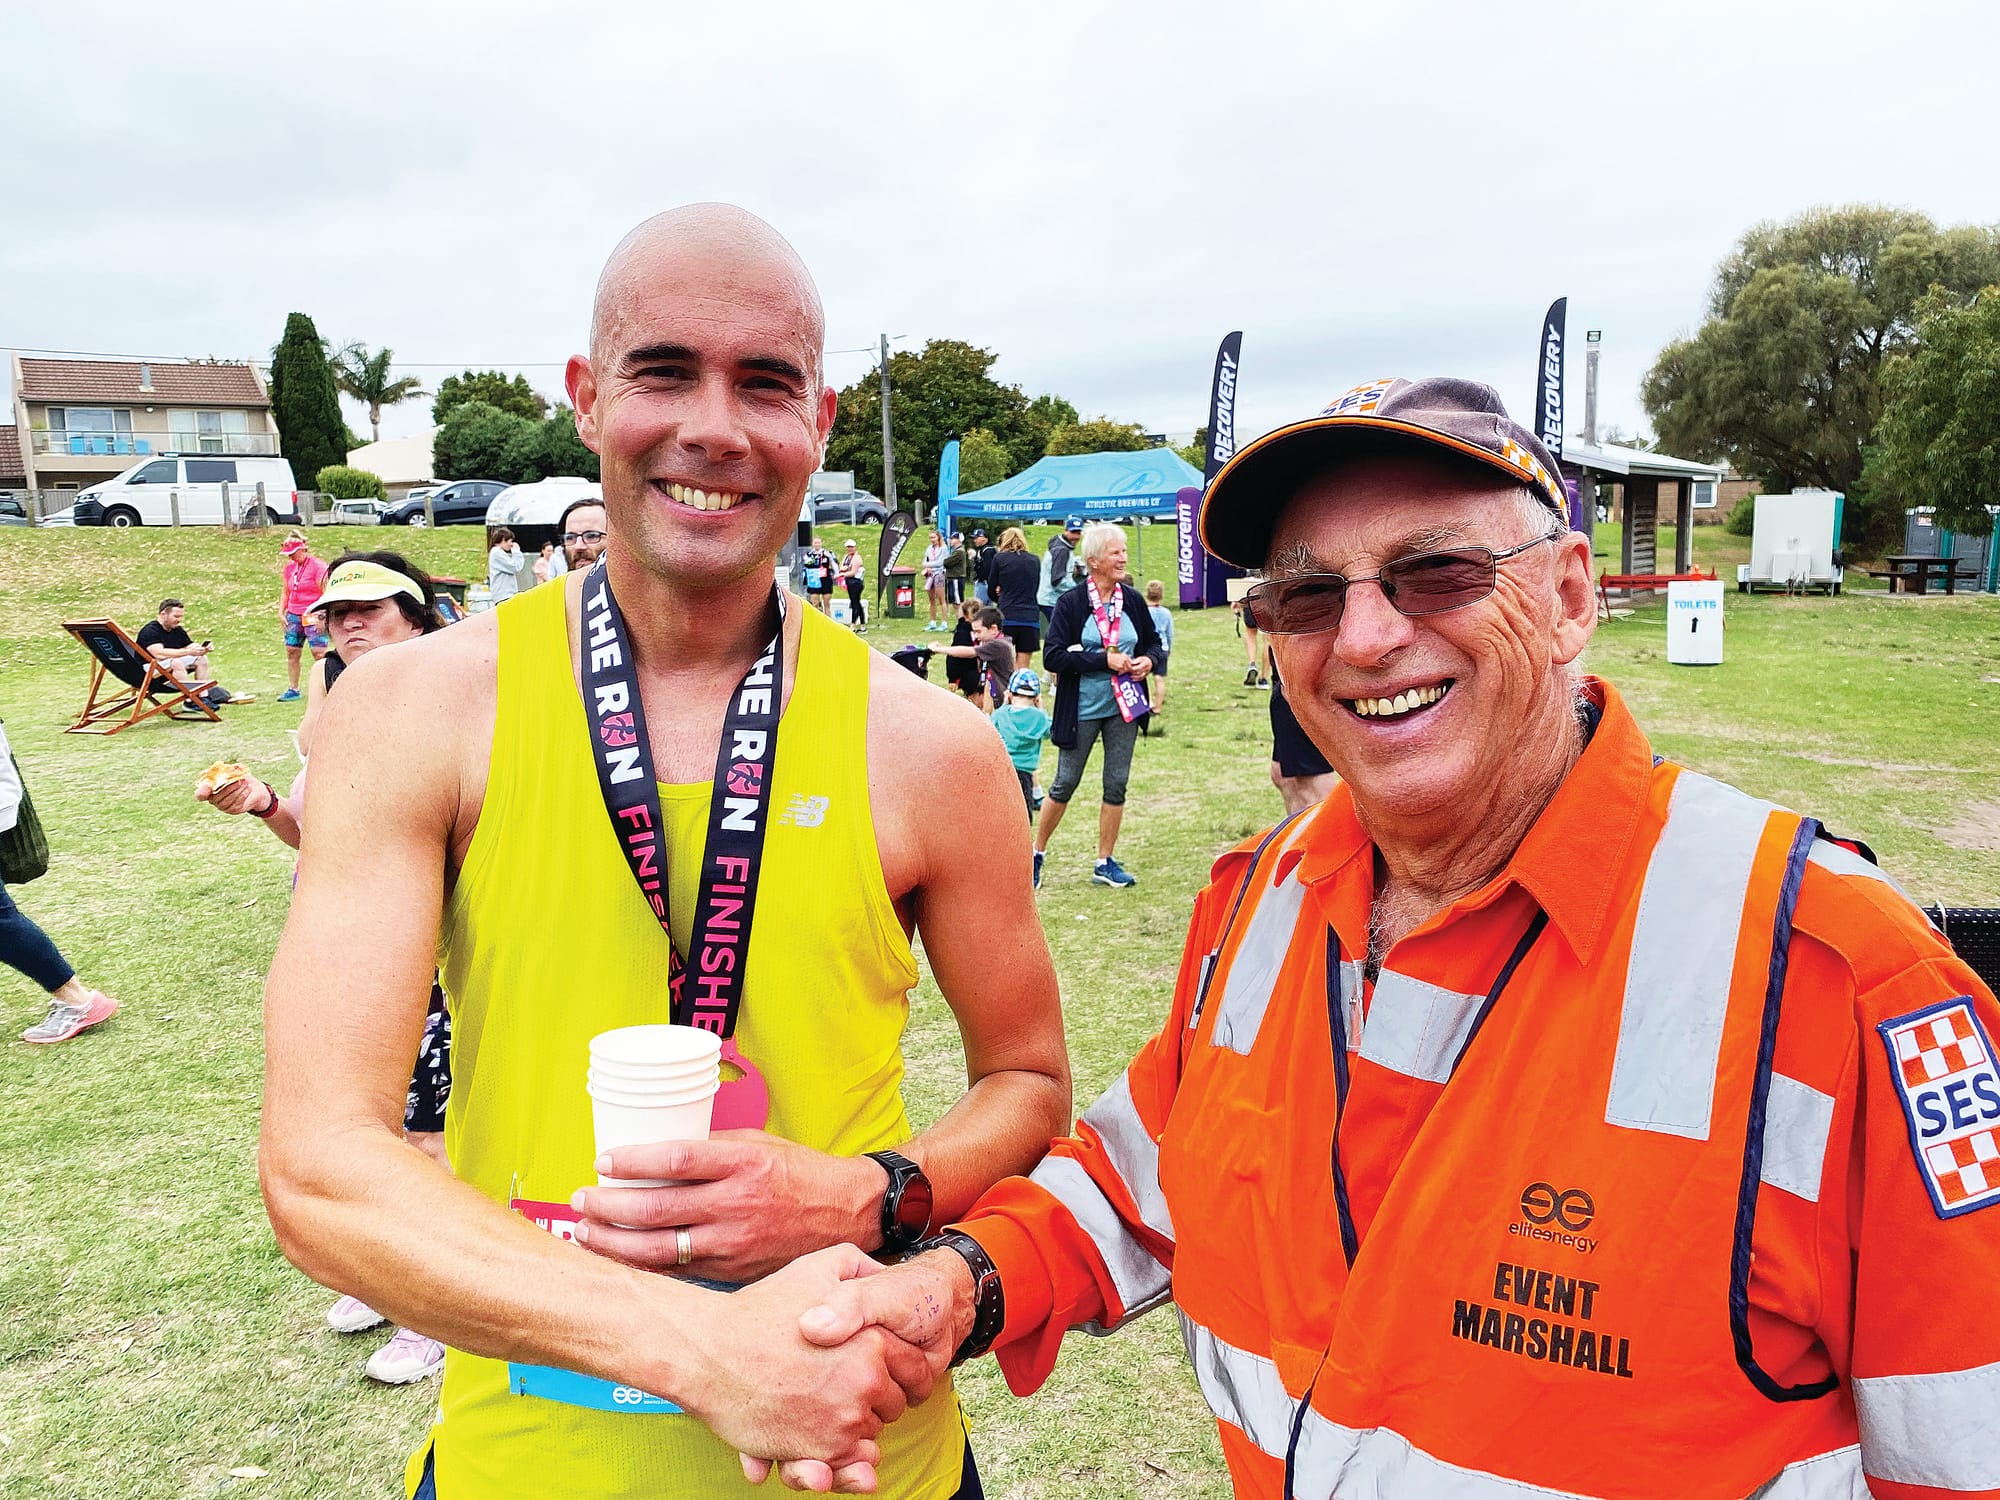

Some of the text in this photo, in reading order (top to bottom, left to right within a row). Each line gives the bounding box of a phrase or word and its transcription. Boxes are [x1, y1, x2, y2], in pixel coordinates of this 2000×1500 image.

[1213, 351, 1239, 464] RECOVERY
[1322, 389, 1384, 416] SES
[1542, 324, 1561, 453] RECOVERY
[587, 581, 623, 673] THE
[1674, 600, 1717, 609] TOILETS
[691, 856, 749, 1036] FINISHE
[1916, 1072, 2000, 1138] SES
[1494, 1262, 1599, 1320] EVENT
[1452, 1299, 1633, 1378] MARSHALL
